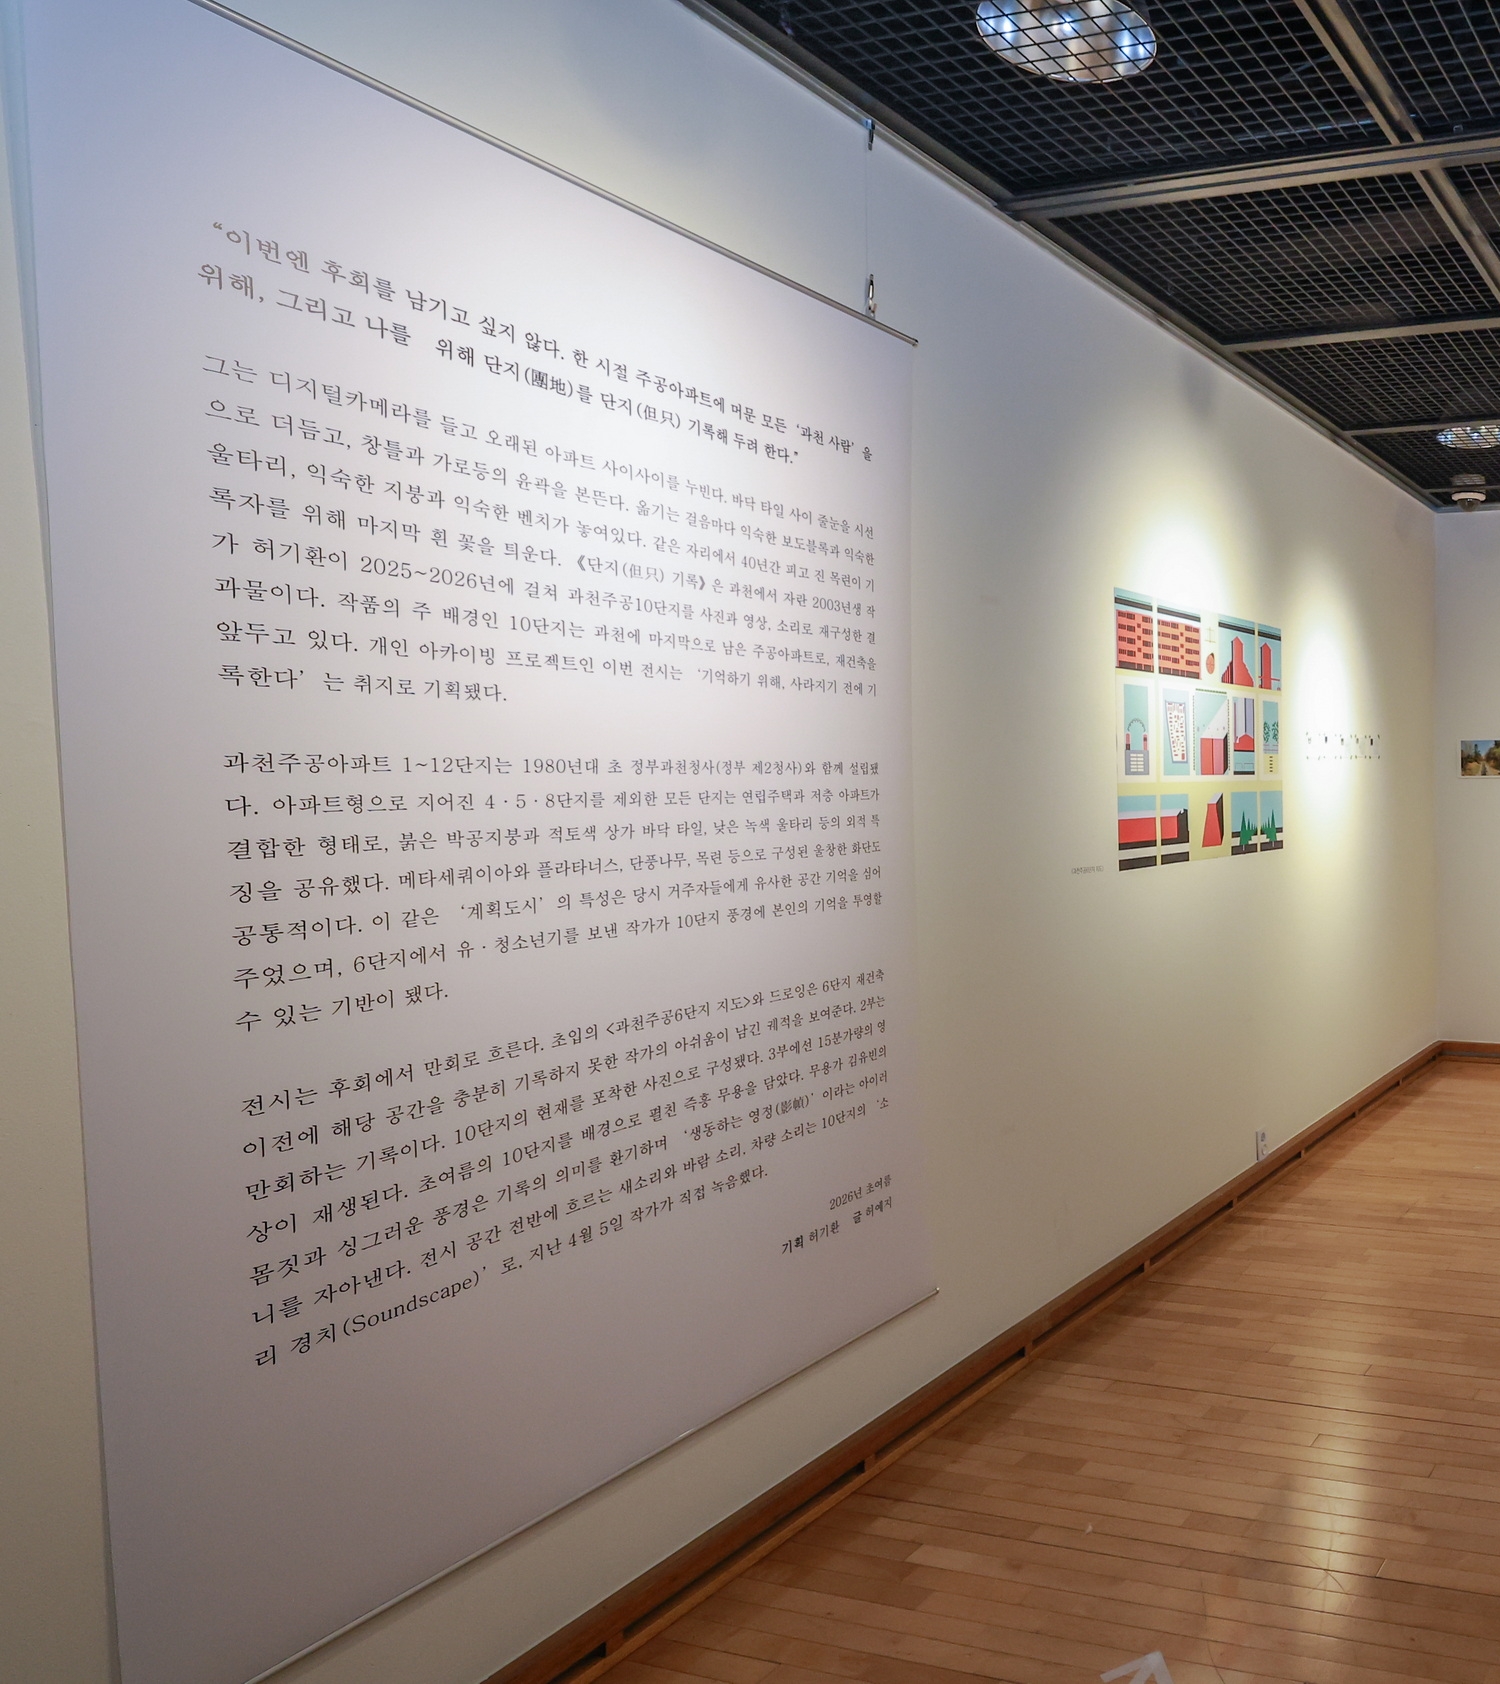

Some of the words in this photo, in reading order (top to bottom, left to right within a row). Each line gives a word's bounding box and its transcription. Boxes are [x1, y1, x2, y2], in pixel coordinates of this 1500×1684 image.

[197, 263, 264, 303] 위해,
[276, 289, 356, 328] 그리고
[364, 316, 412, 347] 나를
[435, 338, 475, 368] 위해
[688, 419, 728, 446] 기록해
[733, 432, 758, 455] 두려
[320, 259, 396, 303] 후회를
[405, 289, 471, 327] 남기고
[478, 315, 515, 345] 싶지
[524, 331, 565, 361] 않다.
[572, 348, 589, 369] 한
[595, 357, 629, 383] 시절
[635, 369, 725, 414] 주공아파트에
[730, 403, 757, 424] 머문
[760, 413, 787, 434] 모든
[202, 354, 258, 384] 그는
[268, 371, 432, 430] 디지털카메라를
[439, 414, 478, 440] 들고
[485, 429, 538, 458] 오래된
[544, 445, 596, 471] 아파트
[602, 459, 680, 492] 사이사이를
[685, 479, 727, 504] 누빈다.
[731, 492, 756, 512] 바닥
[760, 500, 785, 519] 타일
[789, 507, 812, 525] 사이
[817, 513, 851, 535] 줄눈을
[854, 523, 874, 540] 시선
[206, 442, 296, 480] 울타리,
[307, 463, 375, 495] 익숙한
[383, 480, 446, 510] 지붕과
[454, 495, 510, 523] 익숙한
[517, 509, 570, 534] 벤치가
[576, 520, 646, 548] 놓여있다.
[653, 535, 681, 555] 같은
[686, 542, 735, 567] 자리에서
[741, 555, 781, 575] 40년간
[785, 563, 810, 579] 피고
[814, 568, 825, 583] 진
[829, 571, 861, 590] 목련이
[865, 578, 875, 593] 기
[211, 531, 240, 555] 가
[252, 537, 347, 572] 허기환이
[524, 581, 557, 602] 걸쳐
[568, 587, 695, 621] 과천주공10단지를
[700, 607, 738, 626] 사진과
[777, 619, 813, 636] 소리로
[819, 624, 863, 643] 재구성한
[866, 631, 876, 645] 결
[223, 751, 392, 775] 과천주공아파트
[523, 757, 599, 775] 1980년대
[607, 759, 623, 774] 초
[821, 760, 844, 776] 함께
[227, 836, 306, 860] 결합한
[317, 833, 389, 856] 형태로,
[398, 831, 438, 852] 붉은
[446, 826, 540, 849] 박공지붕과
[549, 824, 596, 844] 적토색
[604, 823, 636, 841] 상가
[642, 821, 671, 839] 바닥
[713, 819, 739, 835] 낮은
[745, 817, 770, 833] 녹색
[776, 816, 812, 832] 울타리
[818, 815, 840, 831] 등의
[846, 814, 866, 829] 외적
[870, 814, 880, 828] 특
[229, 880, 283, 904] 징을
[293, 872, 389, 899] 공유했다.
[537, 857, 623, 879] 플라타너스,
[696, 849, 723, 866] 목련
[728, 848, 767, 865] 등으로
[771, 844, 809, 861] 구성된
[813, 841, 848, 858] 울창한
[851, 840, 881, 855] 화단도
[235, 1010, 262, 1033] 수
[273, 1003, 322, 1029] 있는
[331, 989, 394, 1017] 기반이
[404, 981, 448, 1007] 됐다.
[241, 1087, 318, 1117] 전시는
[328, 1063, 413, 1099] 후회에서
[424, 1051, 480, 1077] 만회로
[487, 1036, 544, 1063] 흐른다.
[551, 1023, 598, 1049] 초입의
[769, 982, 818, 1004] 드로잉은
[822, 975, 851, 993] 6단지
[856, 968, 885, 986] 재건축
[242, 1124, 318, 1158] 이전에
[330, 1111, 376, 1137] 해당
[385, 1095, 445, 1126] 공간을
[452, 1079, 506, 1108] 충분히
[514, 1061, 579, 1091] 기록하지
[587, 1052, 619, 1075] 못한
[625, 1041, 668, 1064] 작가의
[674, 1027, 729, 1053] 아쉬움이
[735, 1021, 761, 1040] 남긴
[808, 1001, 857, 1024] 보여준다.
[860, 995, 886, 1012] 2부는
[245, 1163, 347, 1201] 만회하는
[356, 1133, 446, 1171] 기록이다.
[454, 1108, 528, 1145] 10단지의
[536, 1094, 585, 1121] 현재를
[592, 1080, 638, 1106] 포착한
[643, 1065, 701, 1091] 사진으로
[706, 1050, 764, 1076] 구성됐다.
[768, 1037, 813, 1061] 3부에선
[818, 1022, 873, 1049] 15분가량의
[877, 1019, 886, 1034] 영
[246, 1212, 296, 1244] 상이
[312, 1183, 408, 1224] 재생된다.
[418, 1154, 492, 1194] 초여름의
[502, 1131, 574, 1167] 10단지를
[580, 1112, 643, 1141] 배경으로
[649, 1101, 677, 1123] 펼친
[684, 1092, 712, 1112] 즉흥
[717, 1080, 757, 1103] 무용을
[763, 1068, 804, 1091] 담았다.
[809, 1057, 844, 1078] 무용가
[848, 1044, 887, 1068] 김유빈의
[254, 1344, 276, 1367] 리
[529, 1237, 562, 1261] 지난
[568, 1225, 593, 1248] 4월
[599, 1213, 624, 1236] 5일
[630, 1196, 674, 1223] 작가가
[679, 1184, 705, 1205] 직접
[711, 1164, 768, 1193] 녹음했다.
[829, 1187, 862, 1211] 2026년
[865, 1174, 892, 1195] 초여름
